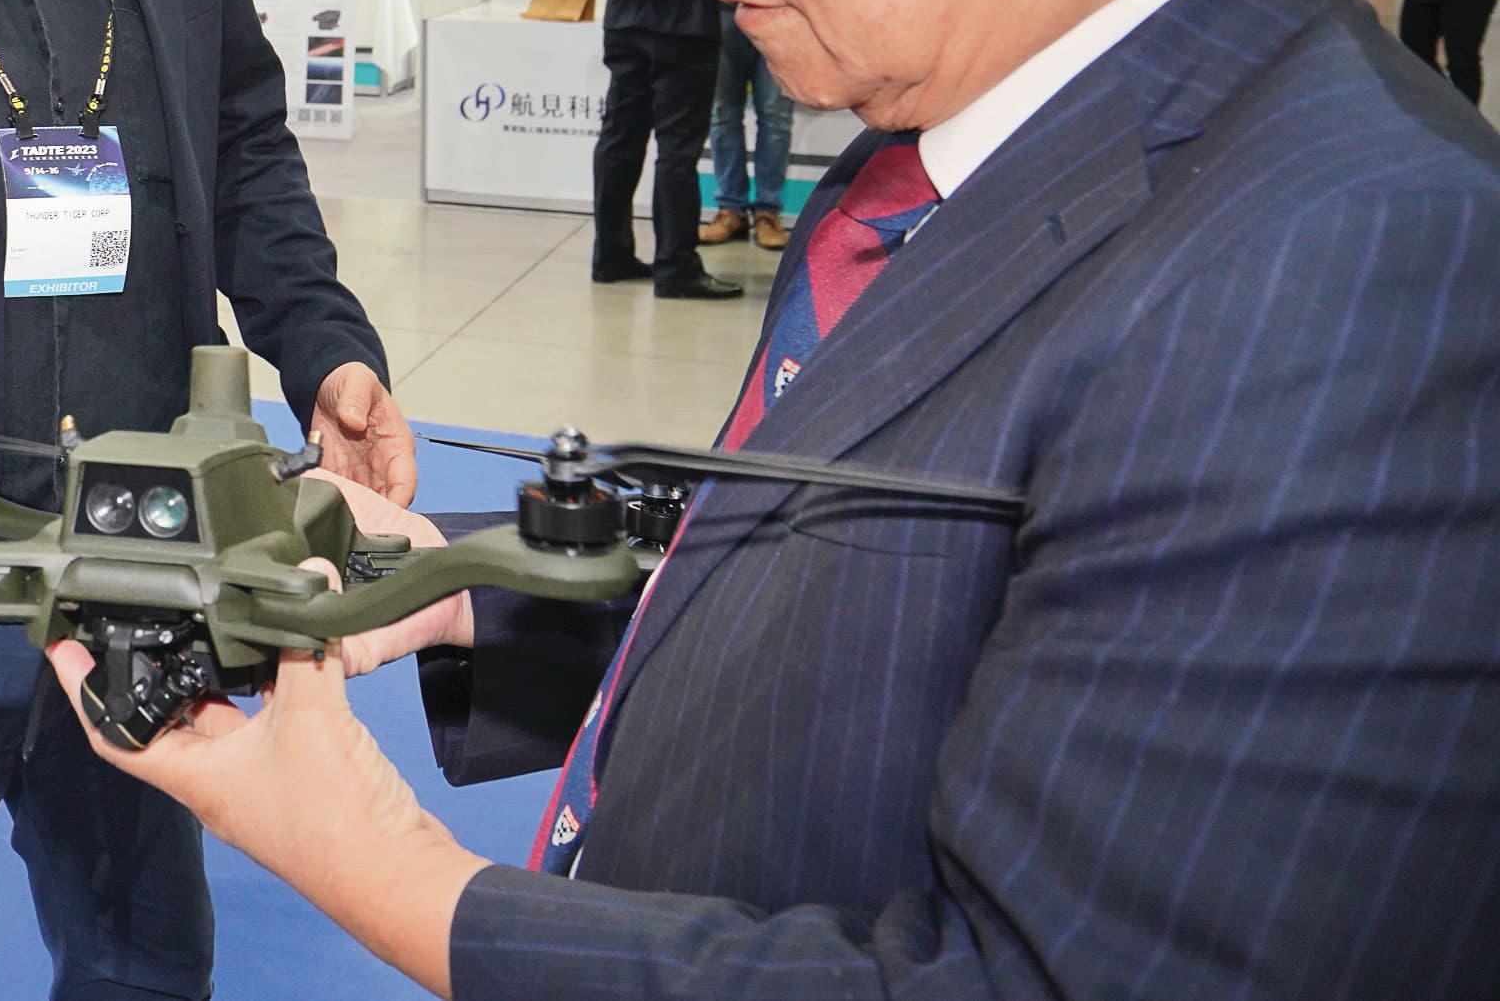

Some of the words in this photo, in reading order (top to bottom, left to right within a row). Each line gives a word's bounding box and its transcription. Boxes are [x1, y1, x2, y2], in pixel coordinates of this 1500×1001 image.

[20, 145, 65, 157] TADTE
[66, 144, 98, 156] 2023
[29, 281, 99, 295] EXHIBITOR
